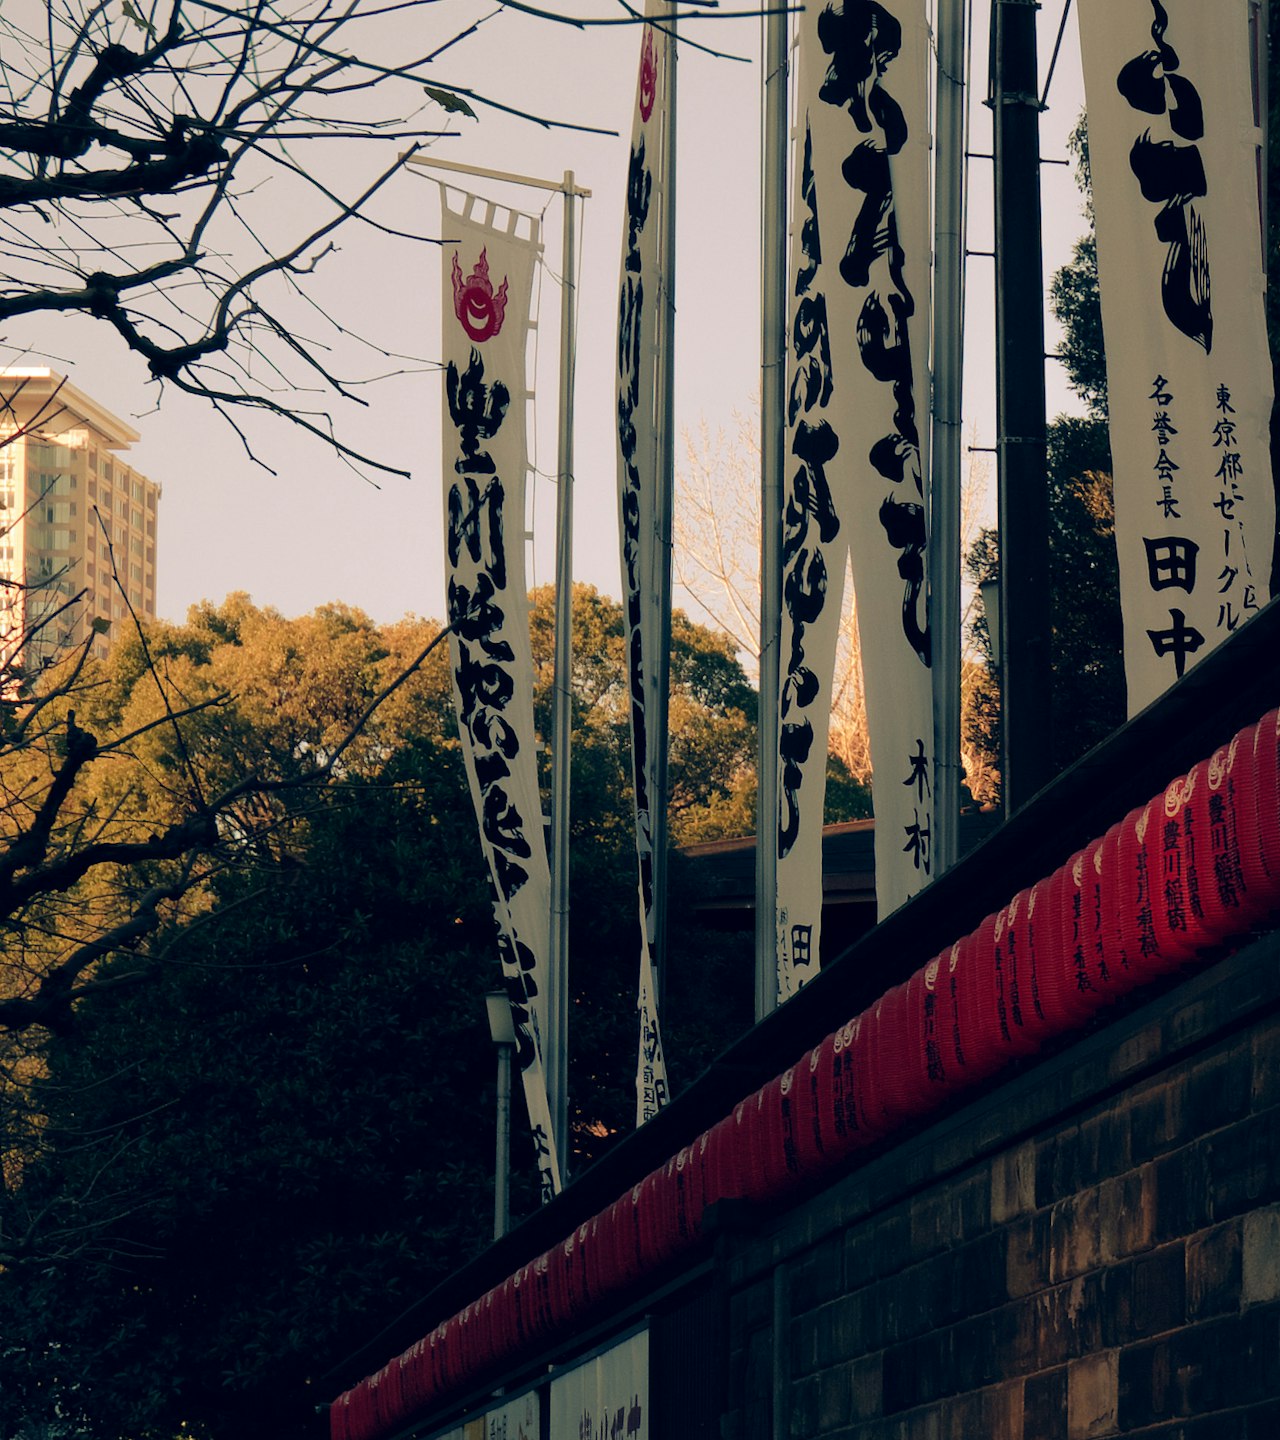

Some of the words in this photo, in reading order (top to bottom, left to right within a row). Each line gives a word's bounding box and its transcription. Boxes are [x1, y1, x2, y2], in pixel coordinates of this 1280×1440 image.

[1148, 374, 1182, 519] 名誉会長
[1142, 536, 1205, 680] 田中
[902, 739, 931, 901] 木村
